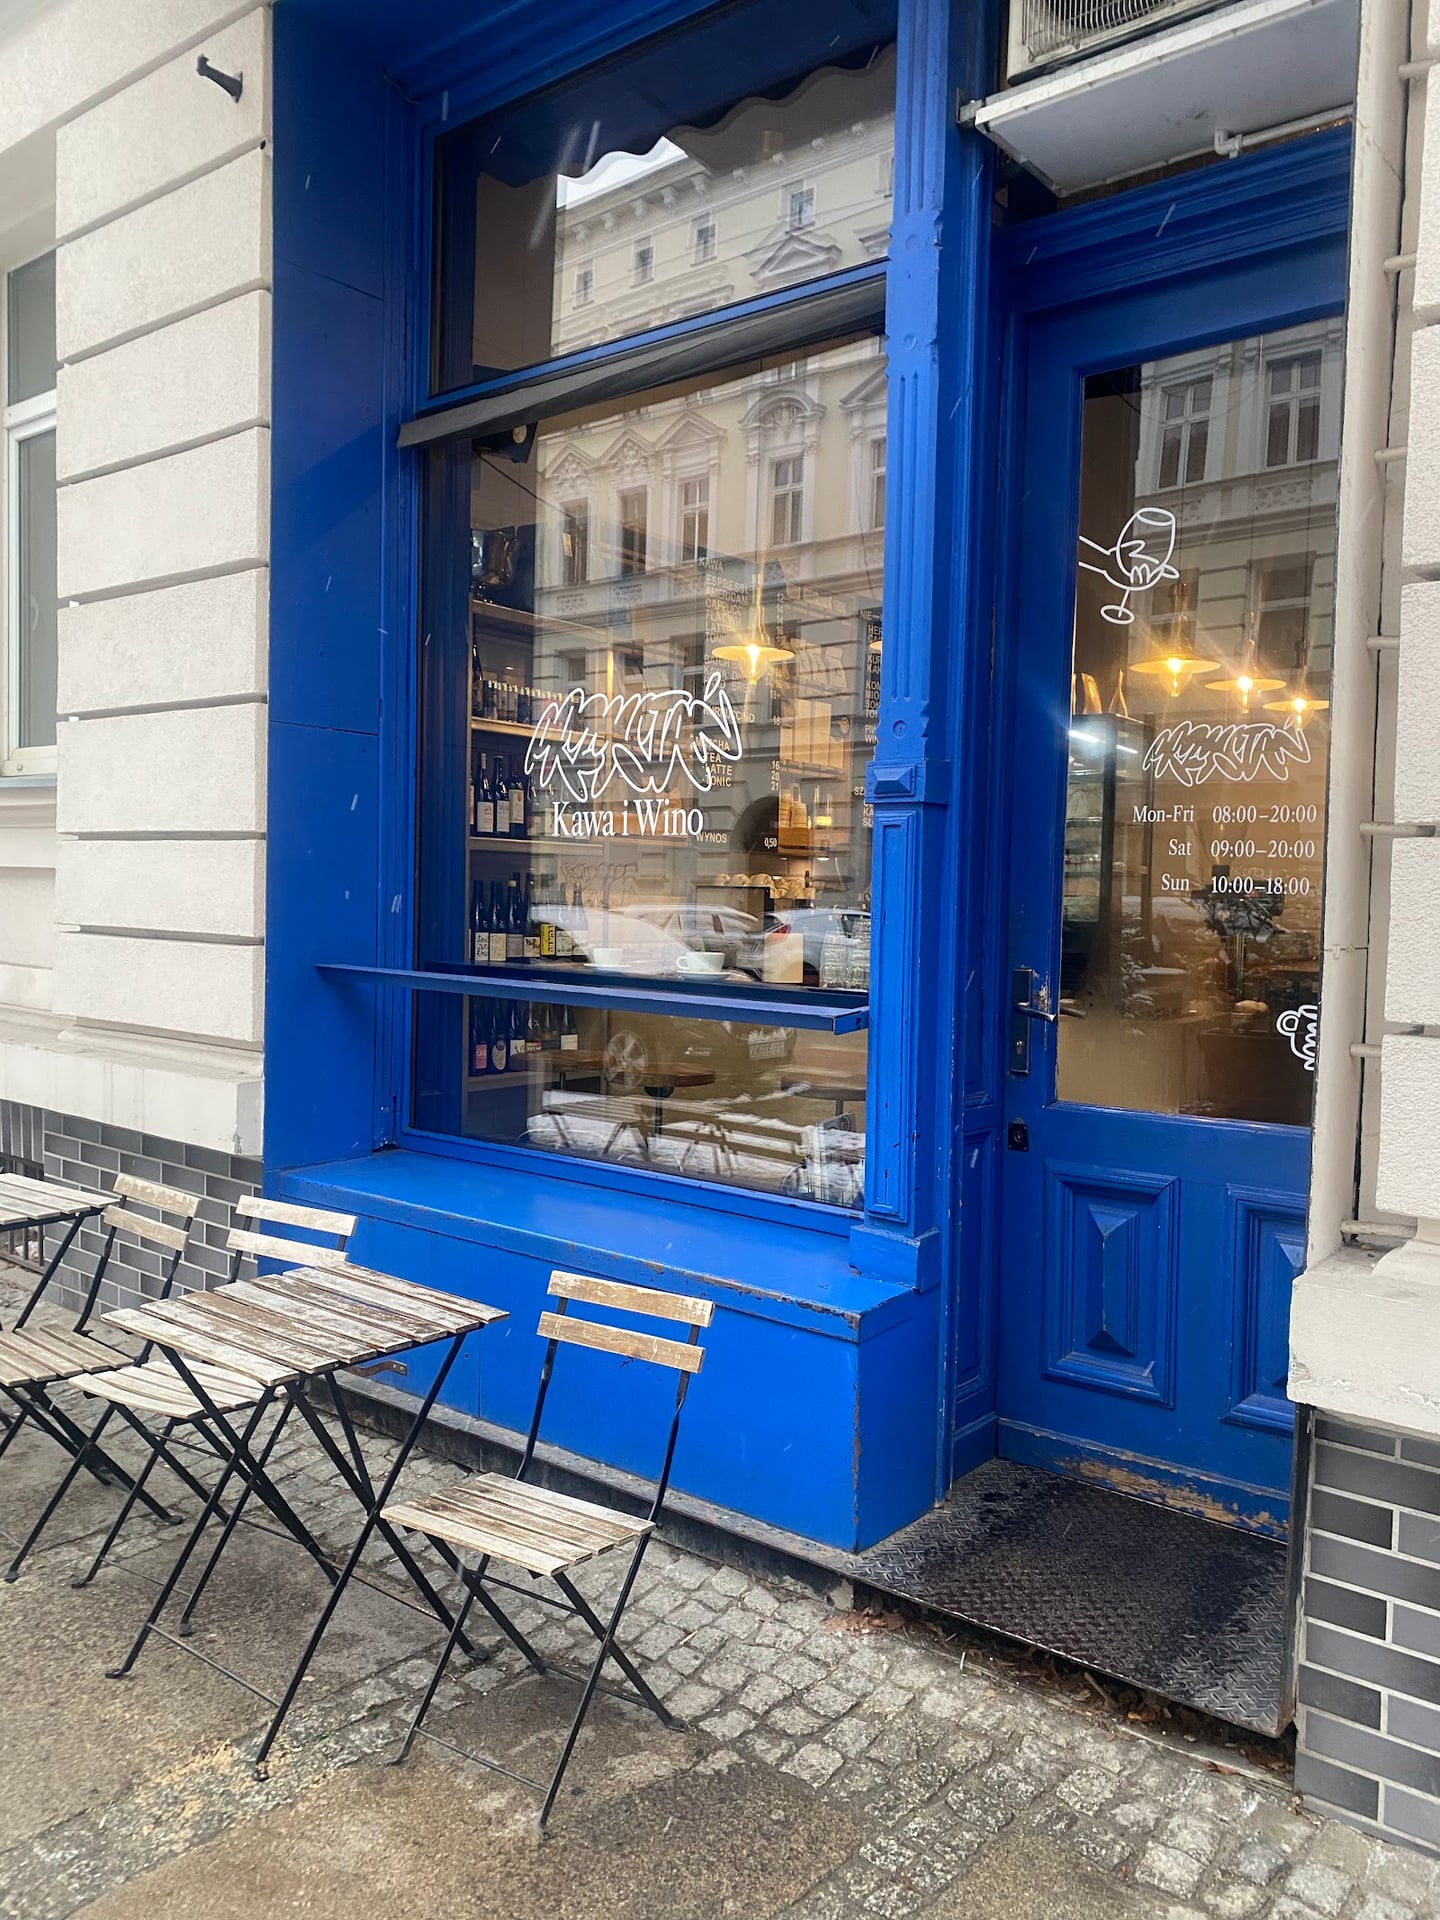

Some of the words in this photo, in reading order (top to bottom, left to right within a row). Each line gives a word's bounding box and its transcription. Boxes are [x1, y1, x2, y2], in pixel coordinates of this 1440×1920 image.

[771, 771, 780, 780] 20
[771, 781, 779, 791] 21
[551, 801, 616, 837] Kawa
[620, 803, 630, 836] i
[633, 799, 704, 837] Wino
[1132, 804, 1195, 823] Mon-Fri
[764, 837, 778, 849] 0,50
[1168, 838, 1193, 856] Sat
[1161, 873, 1190, 892] Sun
